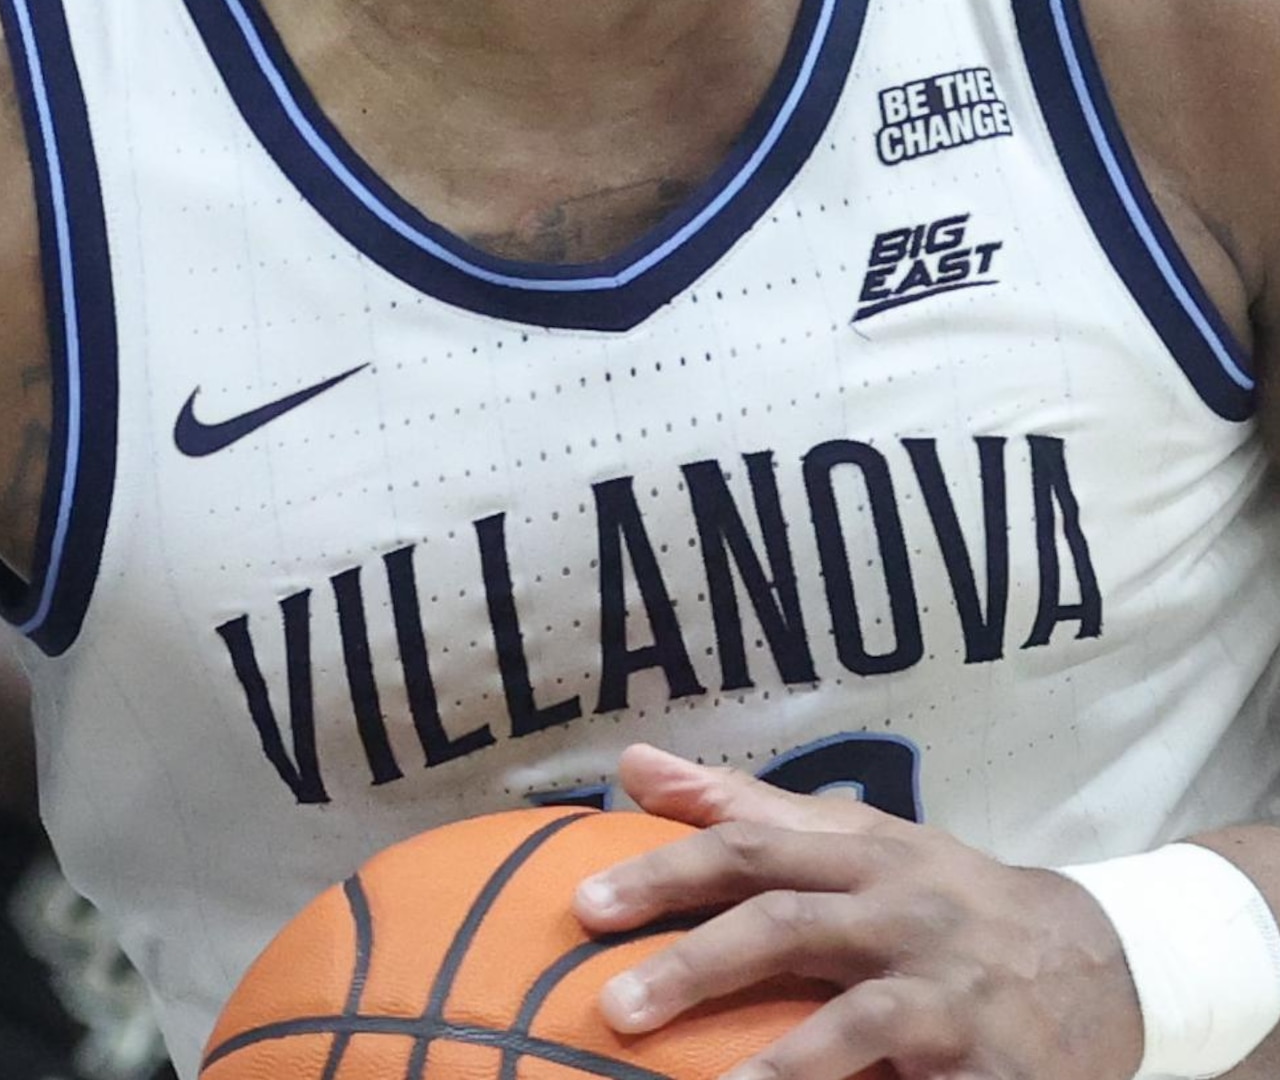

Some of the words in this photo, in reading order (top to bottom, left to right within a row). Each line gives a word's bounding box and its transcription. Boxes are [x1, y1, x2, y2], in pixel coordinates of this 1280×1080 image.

[881, 82, 930, 125] BE
[934, 69, 997, 110] THE
[878, 101, 1012, 164] CHANGE
[868, 213, 971, 267] BIG
[858, 241, 1003, 303] EAST
[215, 434, 1104, 805] VILLANOVA
